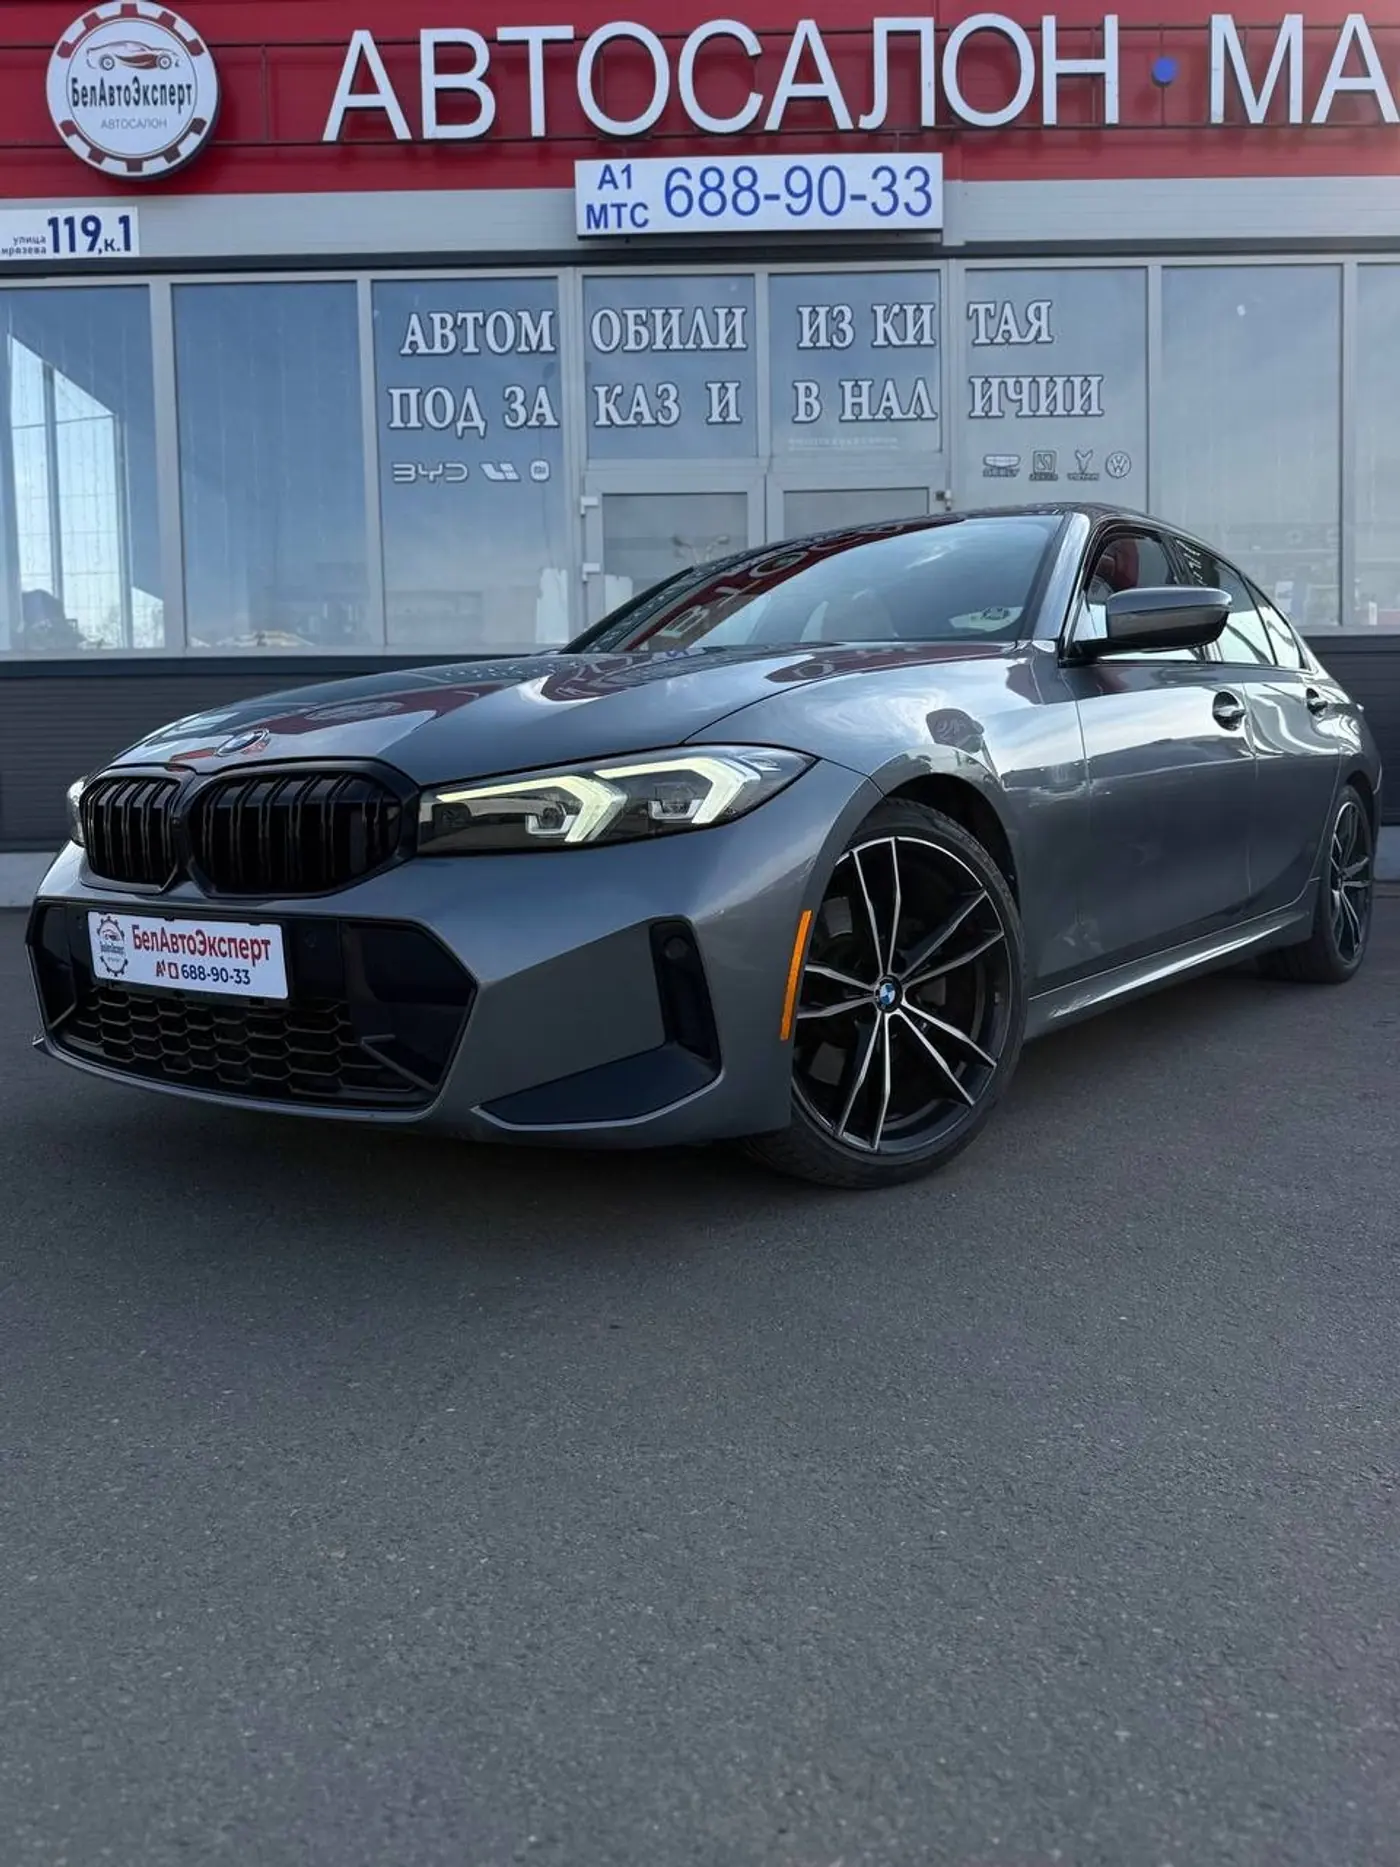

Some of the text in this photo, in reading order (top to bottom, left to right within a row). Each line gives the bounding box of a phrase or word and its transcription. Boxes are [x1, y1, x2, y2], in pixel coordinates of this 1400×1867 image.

[70, 76, 193, 114] БелАвтоЭксперт
[322, 12, 1400, 142] АВТОСАЛОН МА
[101, 117, 168, 130] АВТОСАЛОН
[597, 163, 633, 191] A1
[663, 164, 933, 219] 688-90-33
[585, 202, 650, 230] МТС
[12, 235, 47, 247] улица
[399, 299, 1054, 356] АВТОМ ОБИЛИ ИЗ КИ ТАЯ
[388, 375, 1104, 439] ПОД ЗА КАЗ И В НАЛ ИЧИИ
[131, 924, 272, 967] БелАвтоЭксперт
[180, 963, 252, 986] 688-90-33
